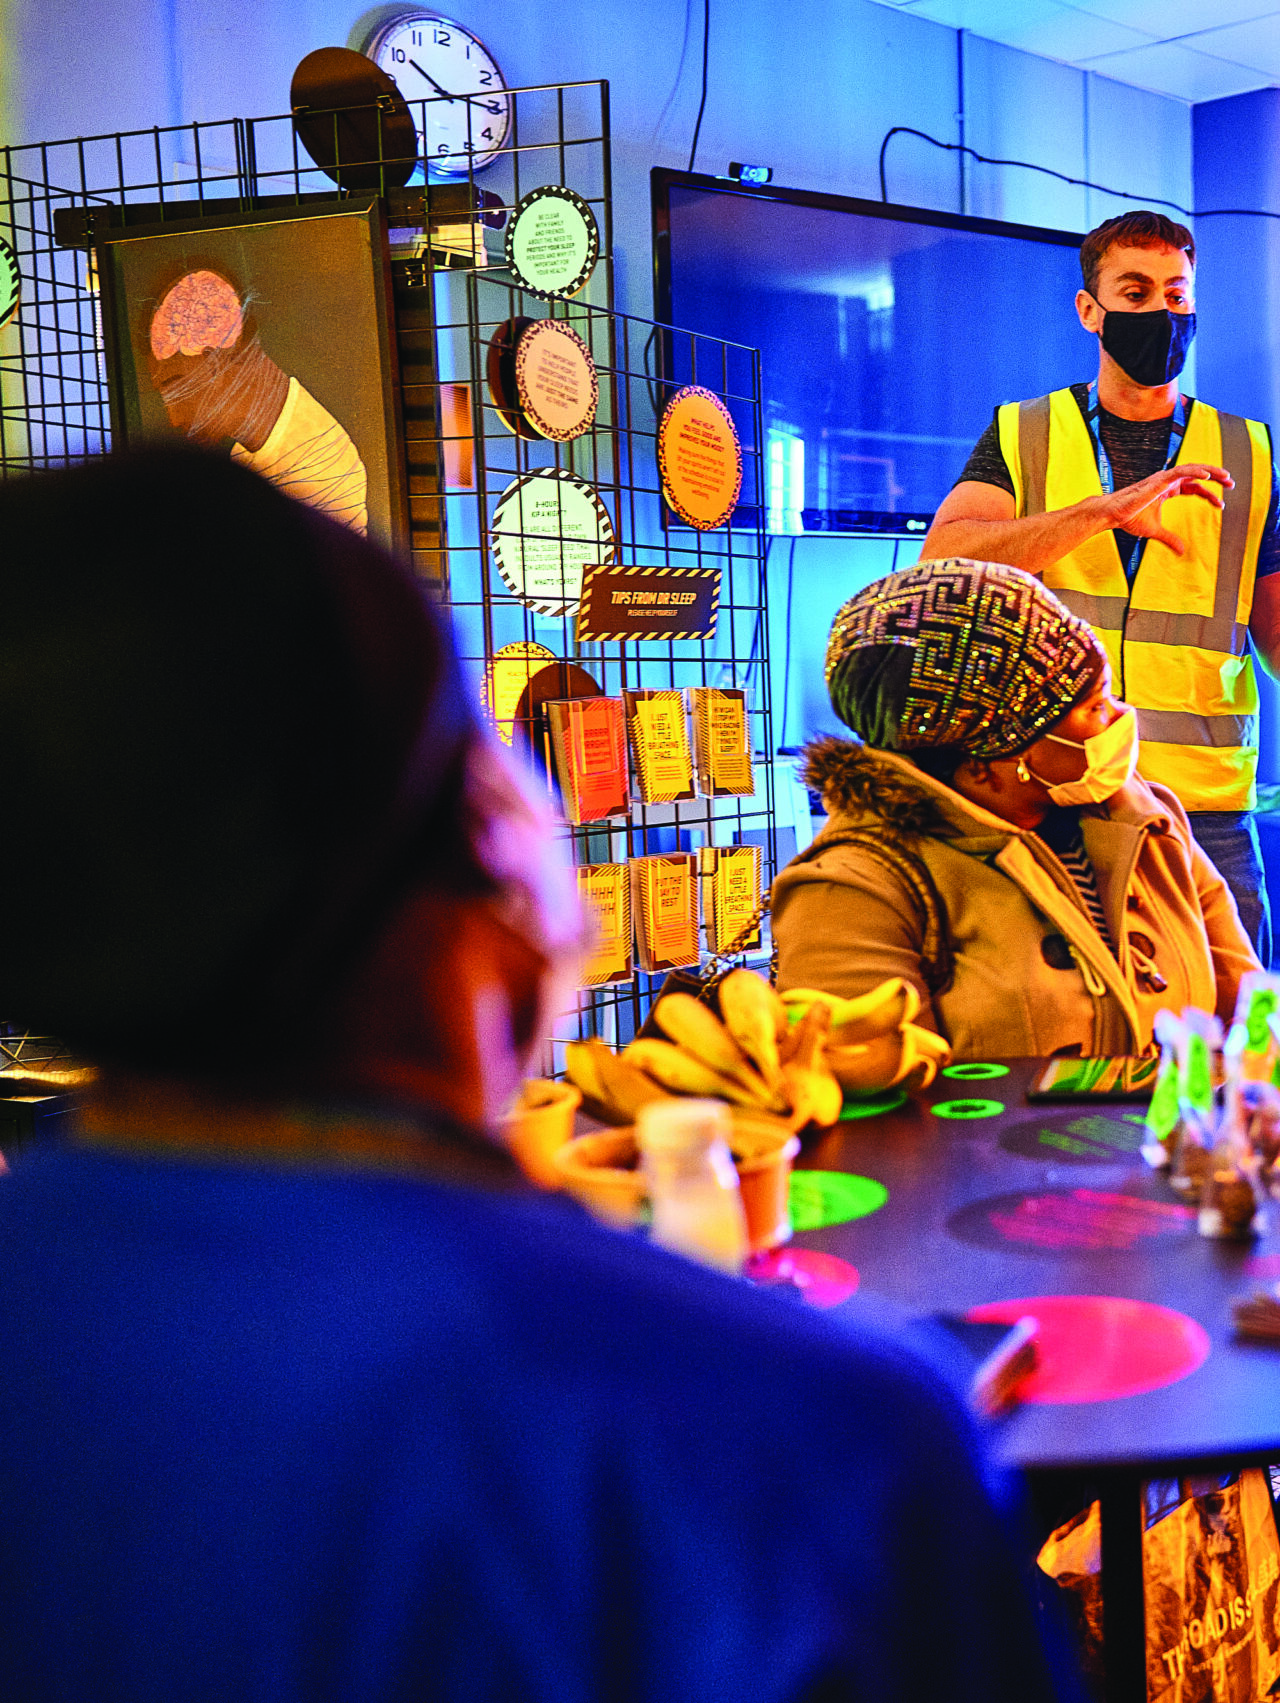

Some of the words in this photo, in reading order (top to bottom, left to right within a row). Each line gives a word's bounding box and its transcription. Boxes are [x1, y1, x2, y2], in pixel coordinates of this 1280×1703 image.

[434, 29, 451, 46] 12
[392, 47, 406, 64] 10
[480, 70, 492, 86] 2
[481, 127, 494, 142] 4
[612, 591, 632, 604] TIPS
[632, 592, 657, 604] FROM
[657, 592, 670, 604] DR
[670, 592, 697, 605] SLEEP
[1228, 1596, 1246, 1630] IS
